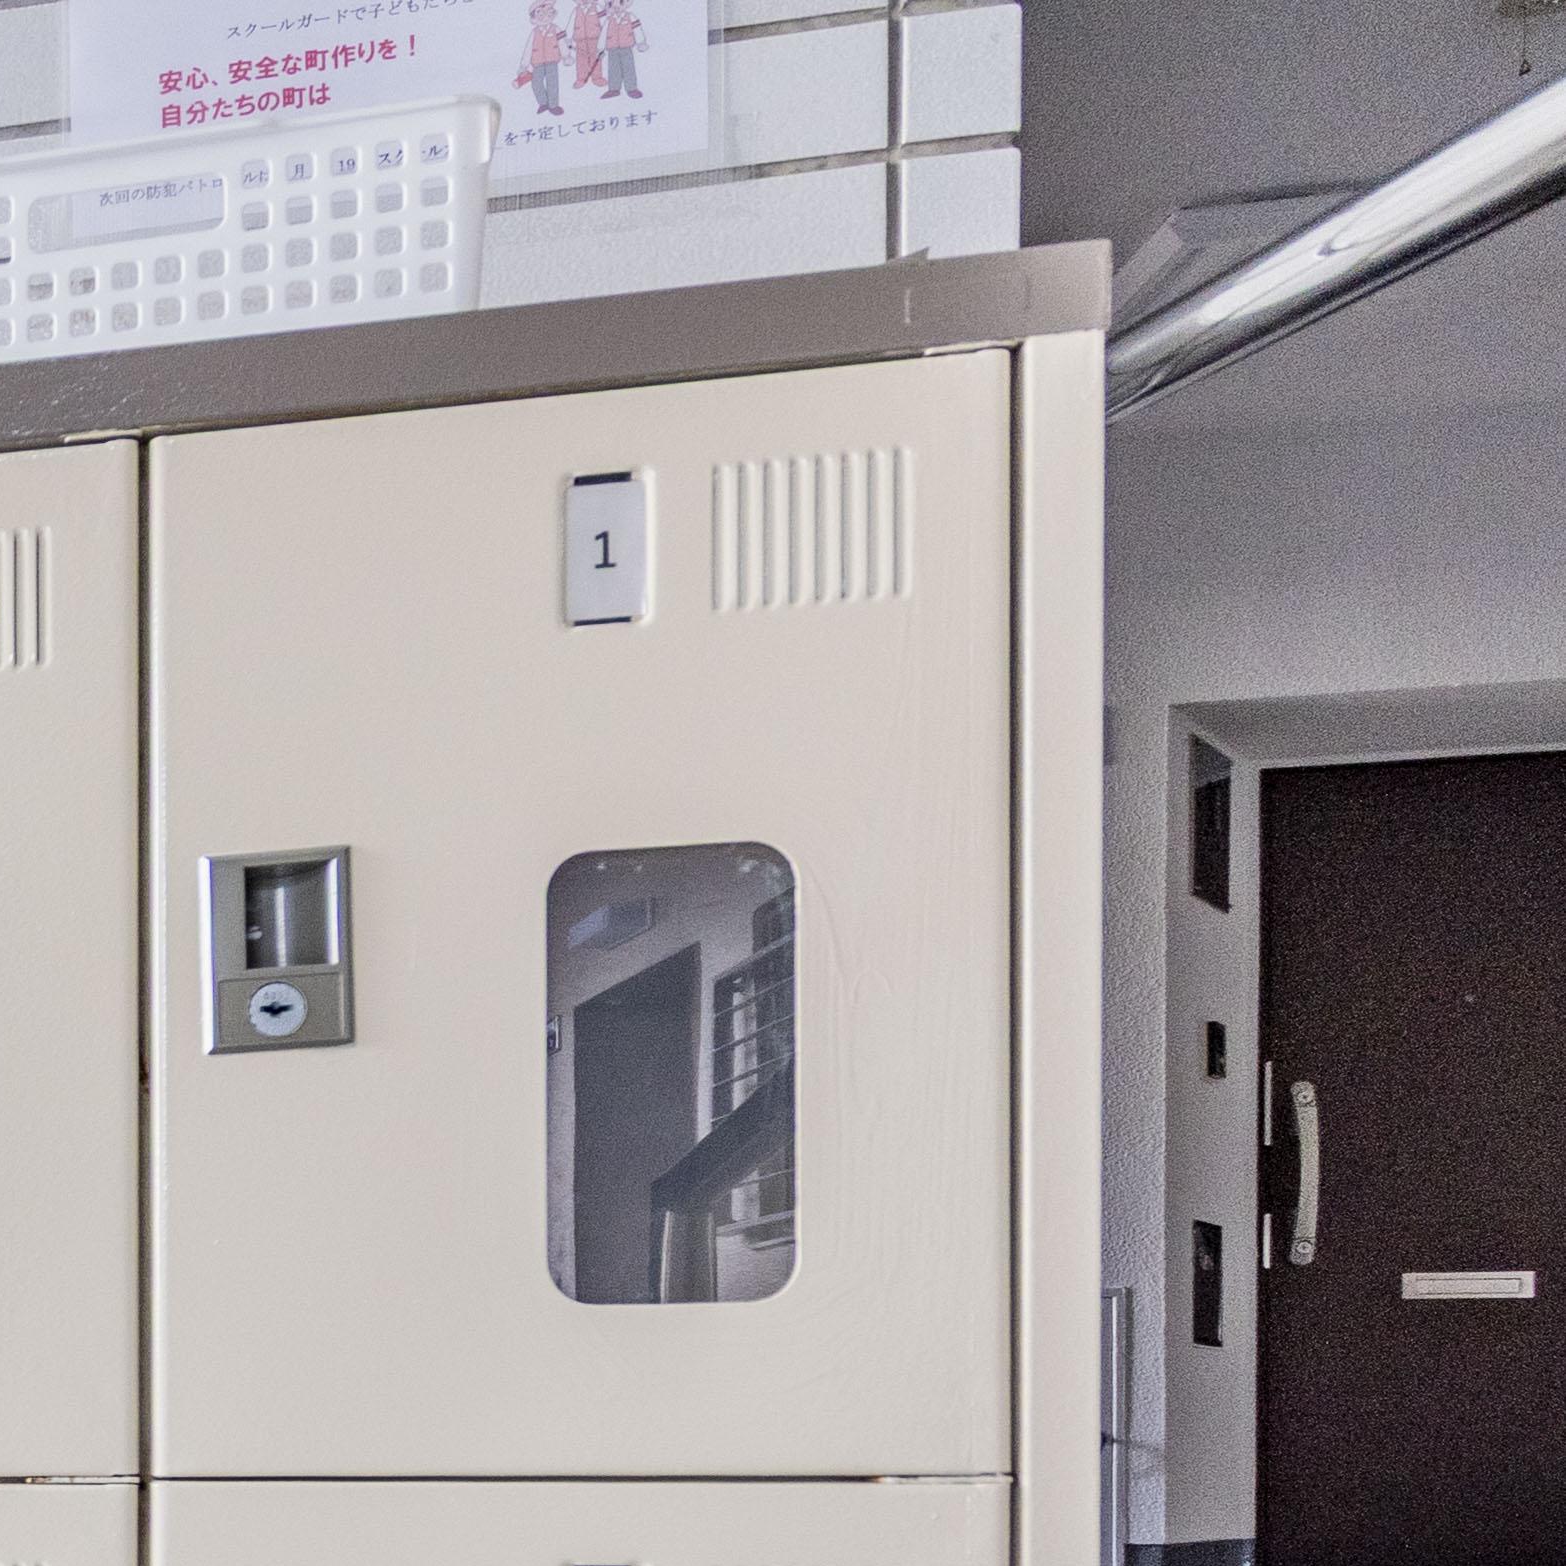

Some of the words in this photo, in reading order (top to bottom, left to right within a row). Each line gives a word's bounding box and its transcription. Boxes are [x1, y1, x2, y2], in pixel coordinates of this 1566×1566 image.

[158, 34, 417, 95] 安心、安全な町作りを！
[160, 82, 332, 129] 自分たちの町は
[594, 530, 617, 569] 1
